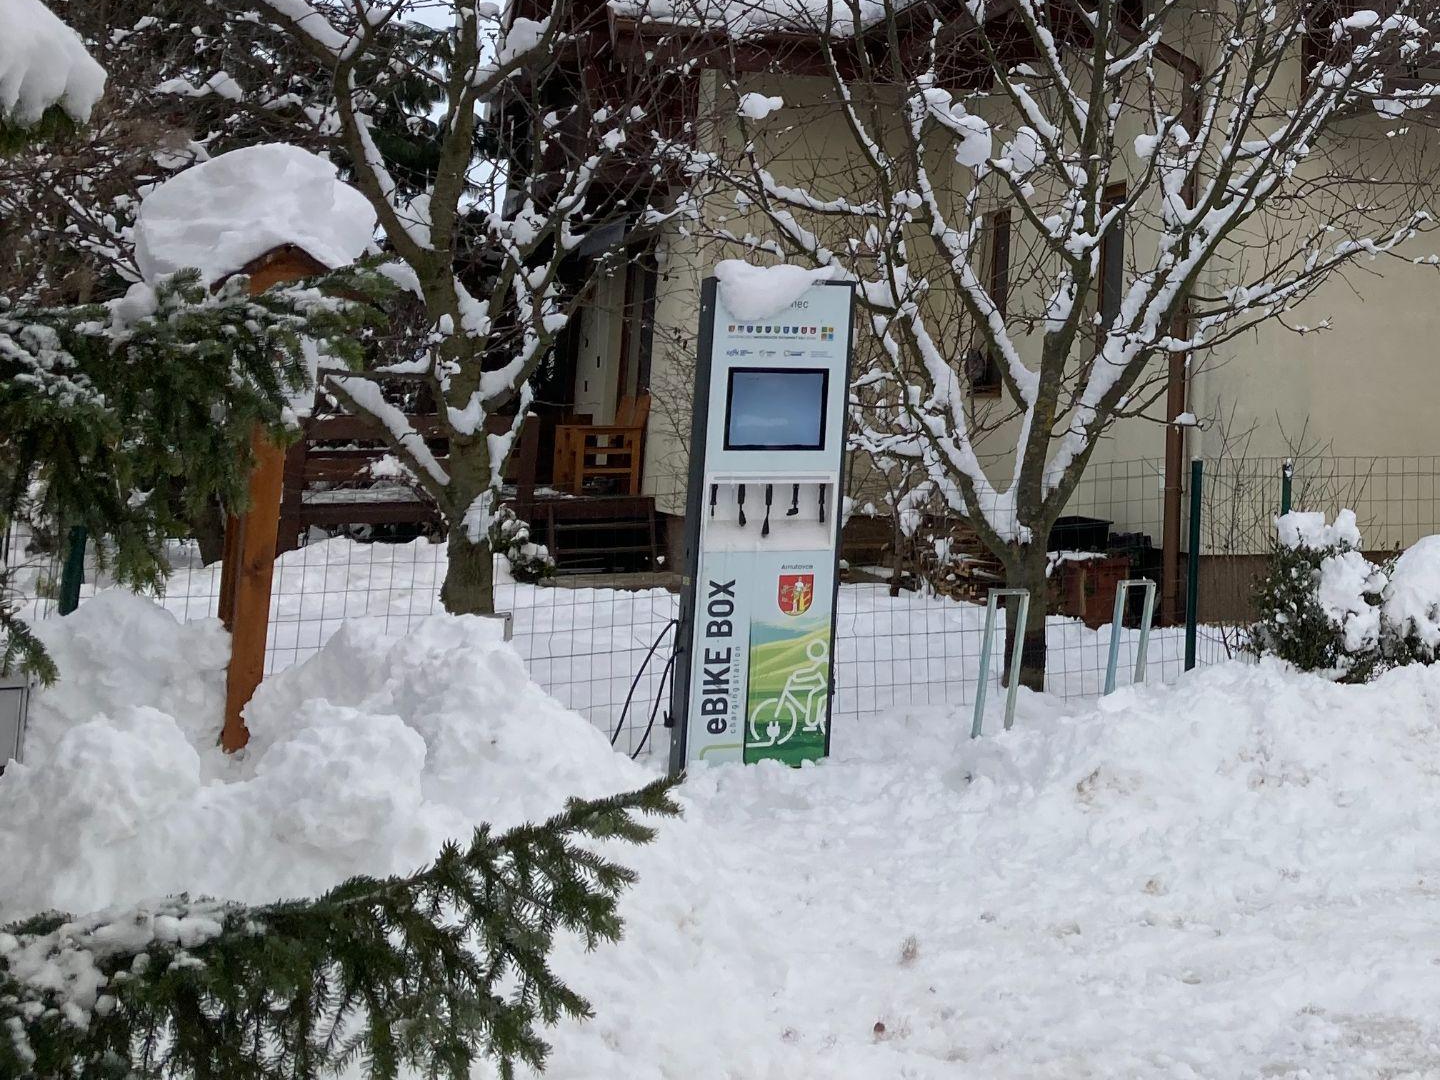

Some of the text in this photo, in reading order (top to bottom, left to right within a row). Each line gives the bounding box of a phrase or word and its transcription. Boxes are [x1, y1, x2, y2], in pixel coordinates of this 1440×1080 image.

[701, 579, 736, 734] eBIKE BOX
[730, 646, 741, 734] charging station
